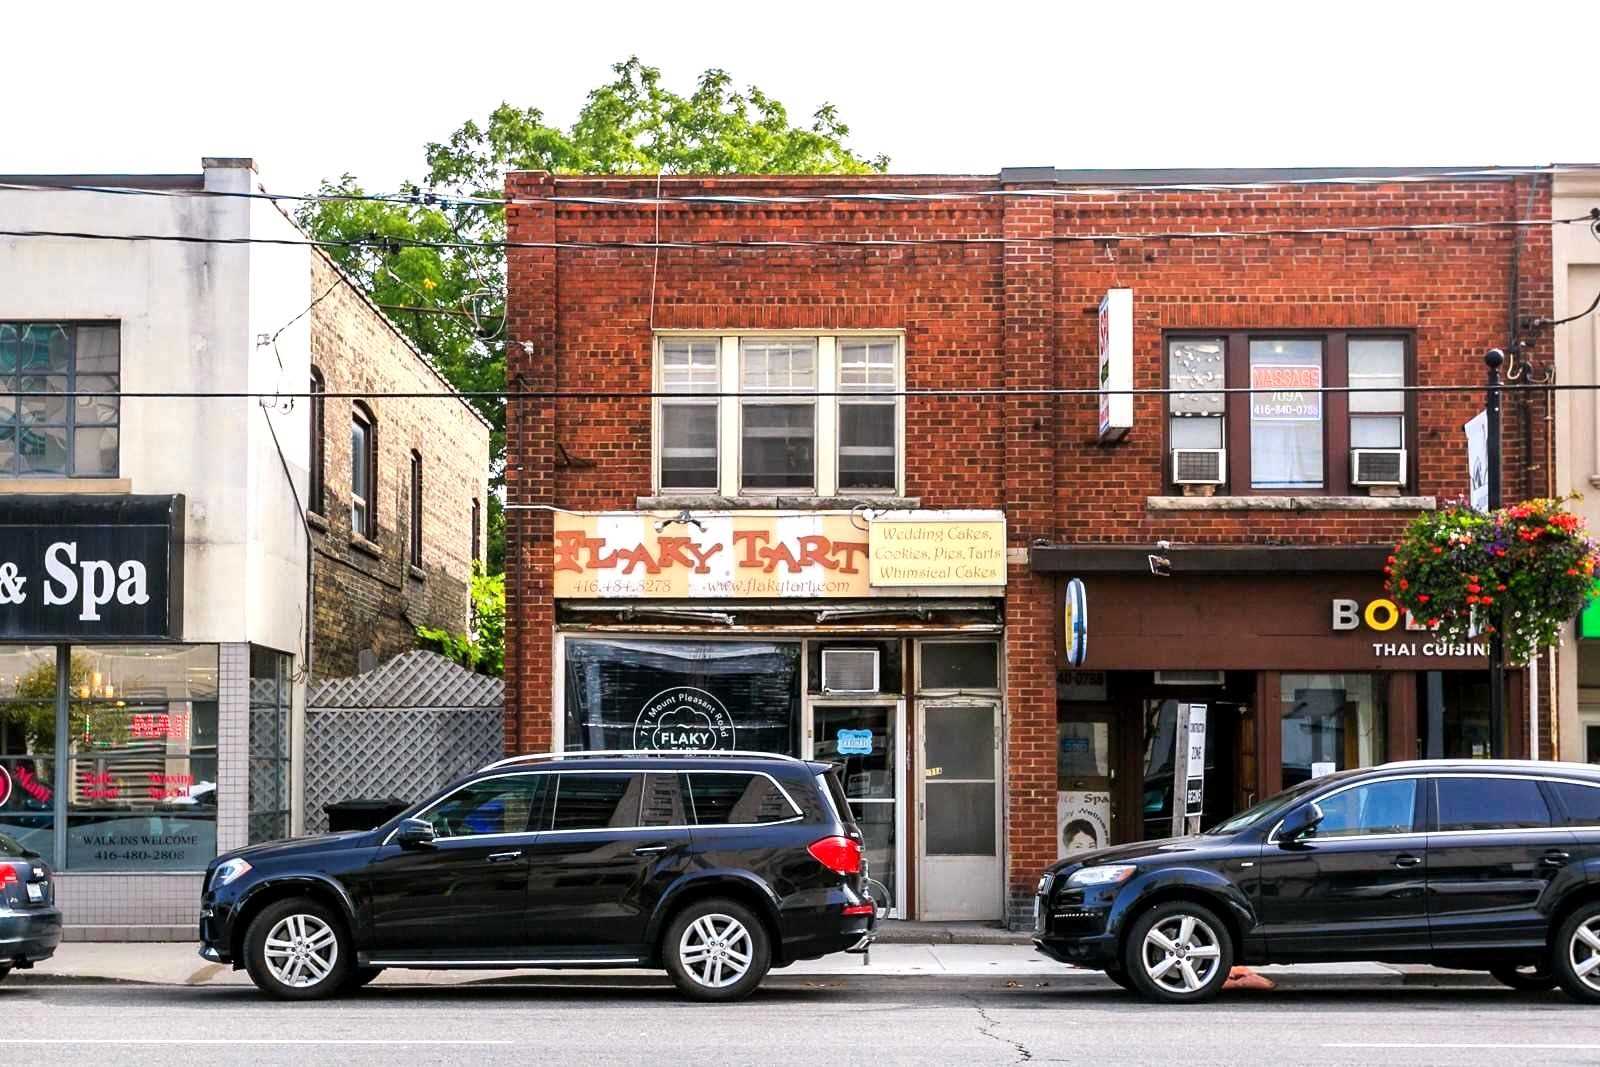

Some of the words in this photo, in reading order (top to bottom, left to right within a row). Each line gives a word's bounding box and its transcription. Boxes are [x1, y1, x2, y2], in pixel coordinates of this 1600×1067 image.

[1254, 369, 1319, 387] MASSAGE
[883, 527, 944, 542] Wedding
[947, 526, 992, 541] Cakes,
[554, 530, 723, 574] FLAKY
[732, 530, 870, 574] TART
[968, 546, 1001, 560] Tarts
[880, 566, 951, 579] Whimsical
[955, 565, 997, 578] Cakes
[0, 562, 27, 605] &
[43, 541, 150, 621] Spa
[707, 576, 851, 595] www.flakytart.com
[1373, 643, 1416, 656] THAI
[1422, 642, 1491, 657] CUISIN
[648, 696, 677, 718] Mount
[679, 693, 716, 714] Pleasant
[714, 712, 729, 738] Road
[661, 732, 710, 745] FLAKY
[1084, 793, 1109, 805] Spa
[140, 835, 199, 846] WELCOME
